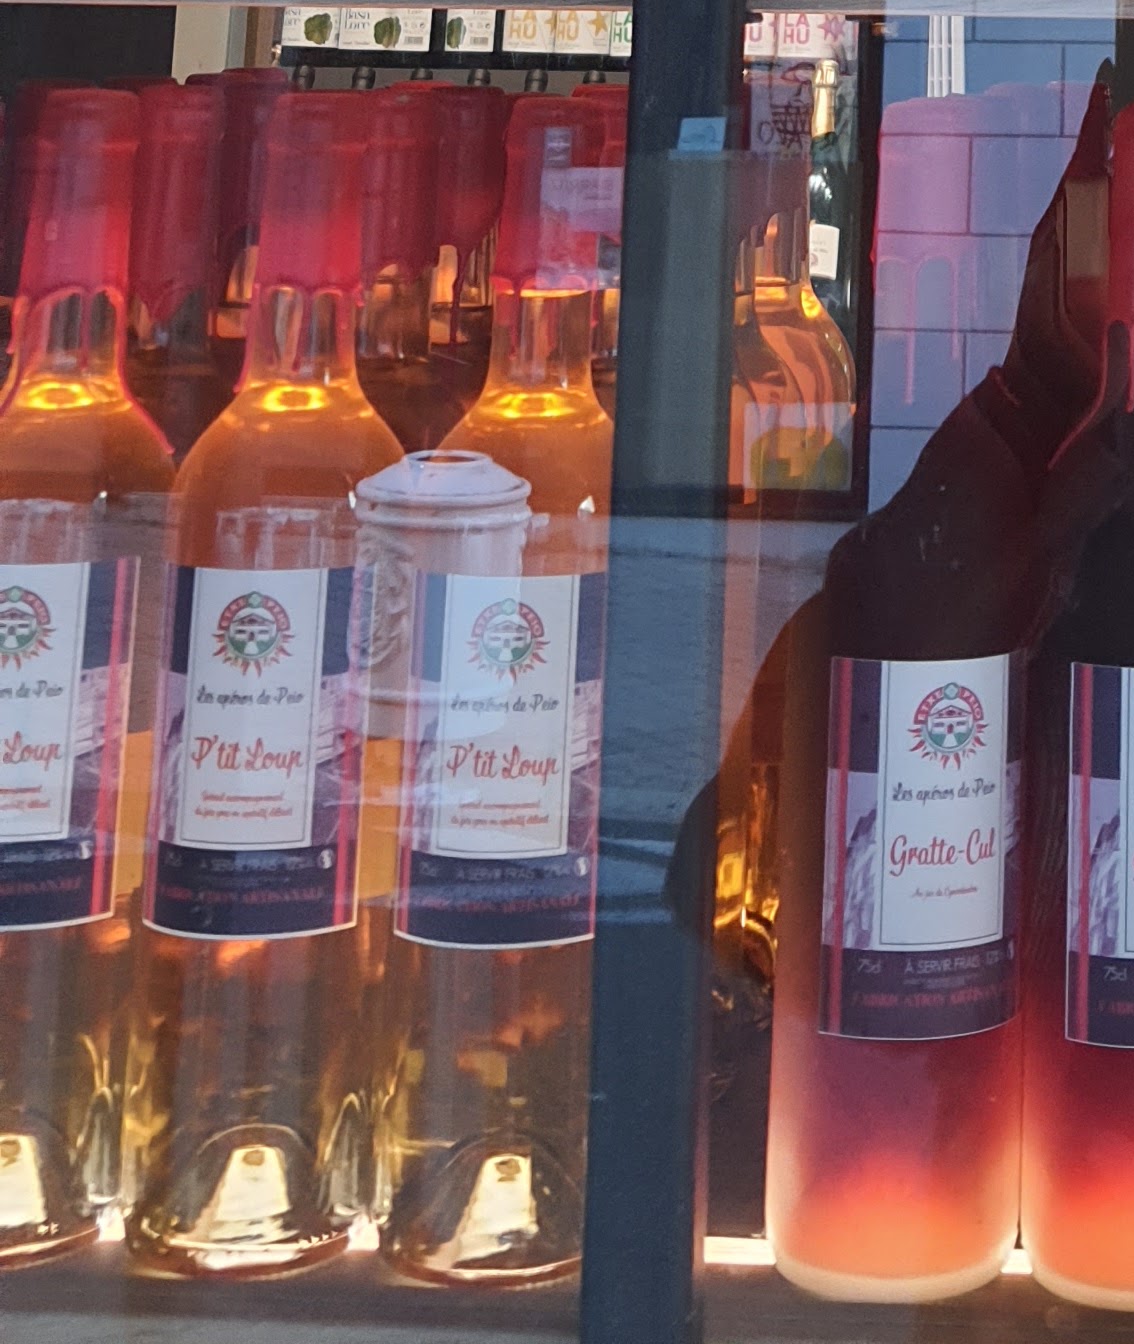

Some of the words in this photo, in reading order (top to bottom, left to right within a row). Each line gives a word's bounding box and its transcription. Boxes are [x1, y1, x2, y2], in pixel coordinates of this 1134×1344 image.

[783, 27, 810, 45] HU
[190, 734, 241, 771] P'tit
[244, 736, 304, 779] Loup
[446, 742, 498, 779] P'tit
[501, 744, 559, 786] Loup
[892, 781, 913, 802] Les
[916, 784, 955, 807] apéros
[957, 781, 970, 799] de
[889, 827, 996, 877] Gratte-Cul
